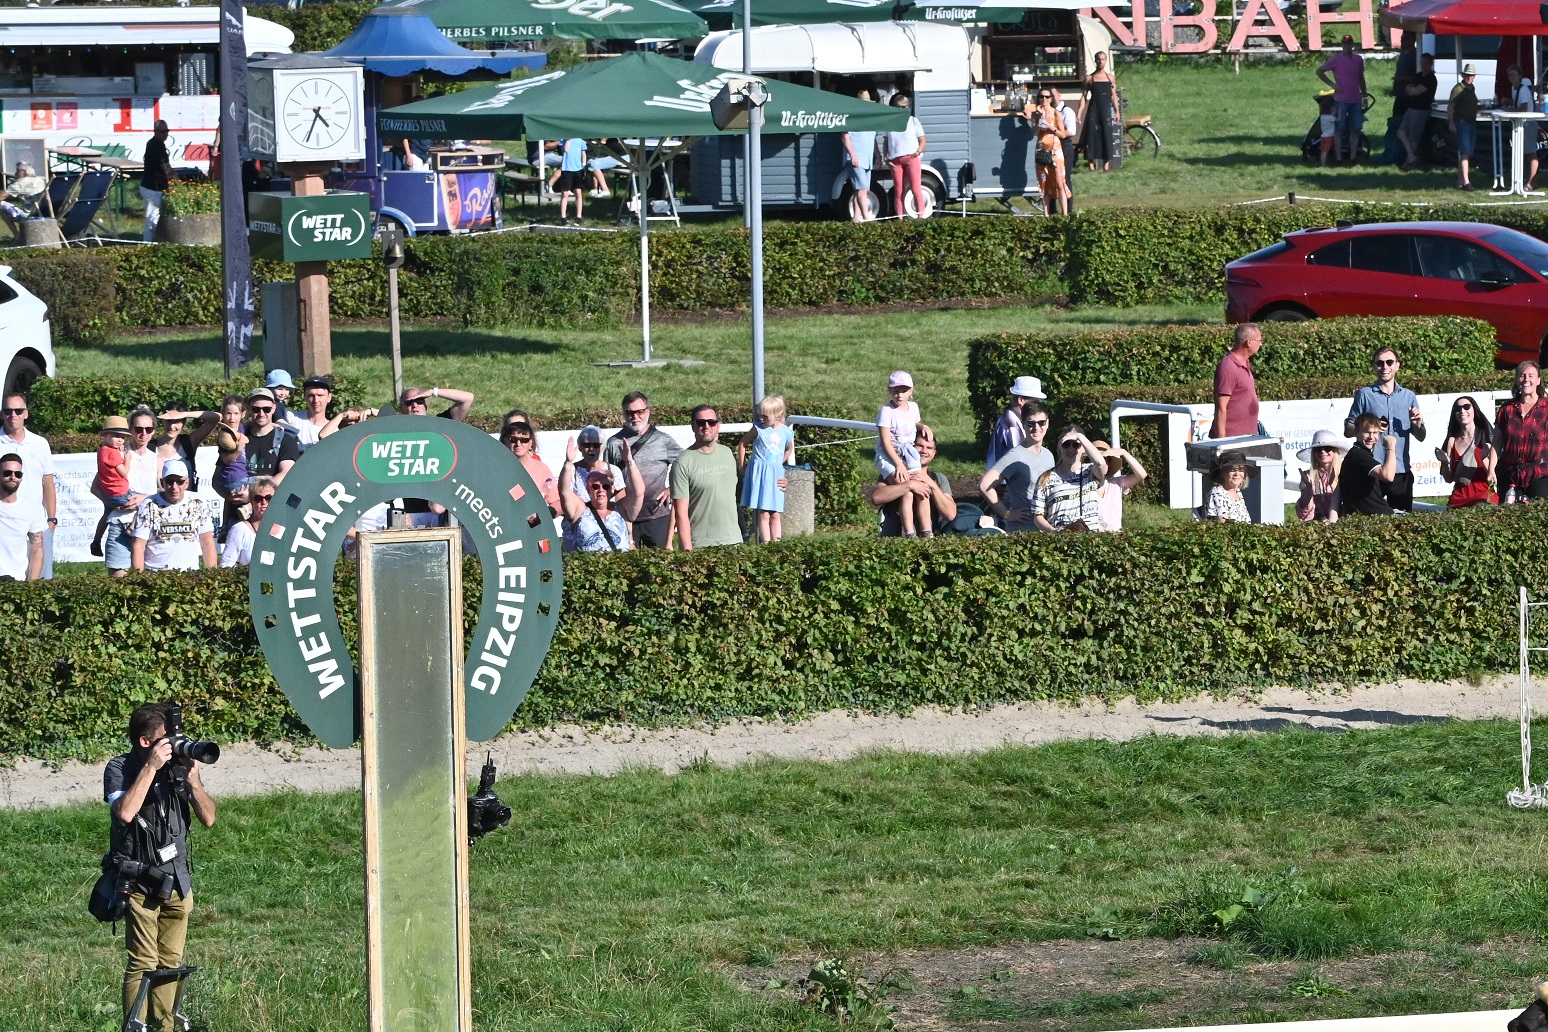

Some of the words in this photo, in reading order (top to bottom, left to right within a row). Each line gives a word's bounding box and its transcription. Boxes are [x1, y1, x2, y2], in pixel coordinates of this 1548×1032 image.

[491, 25, 544, 37] PILSNER
[420, 120, 447, 132] PILSNER
[302, 214, 344, 229] WETT
[313, 227, 352, 242] STAR
[372, 440, 430, 459] WETT
[387, 457, 440, 477] STAR
[1417, 475, 1437, 485] Zeit
[454, 484, 504, 540] meets
[161, 524, 192, 534] VERSACE
[286, 481, 357, 700] WETTSTAR
[470, 539, 527, 696] LEIPZIG
